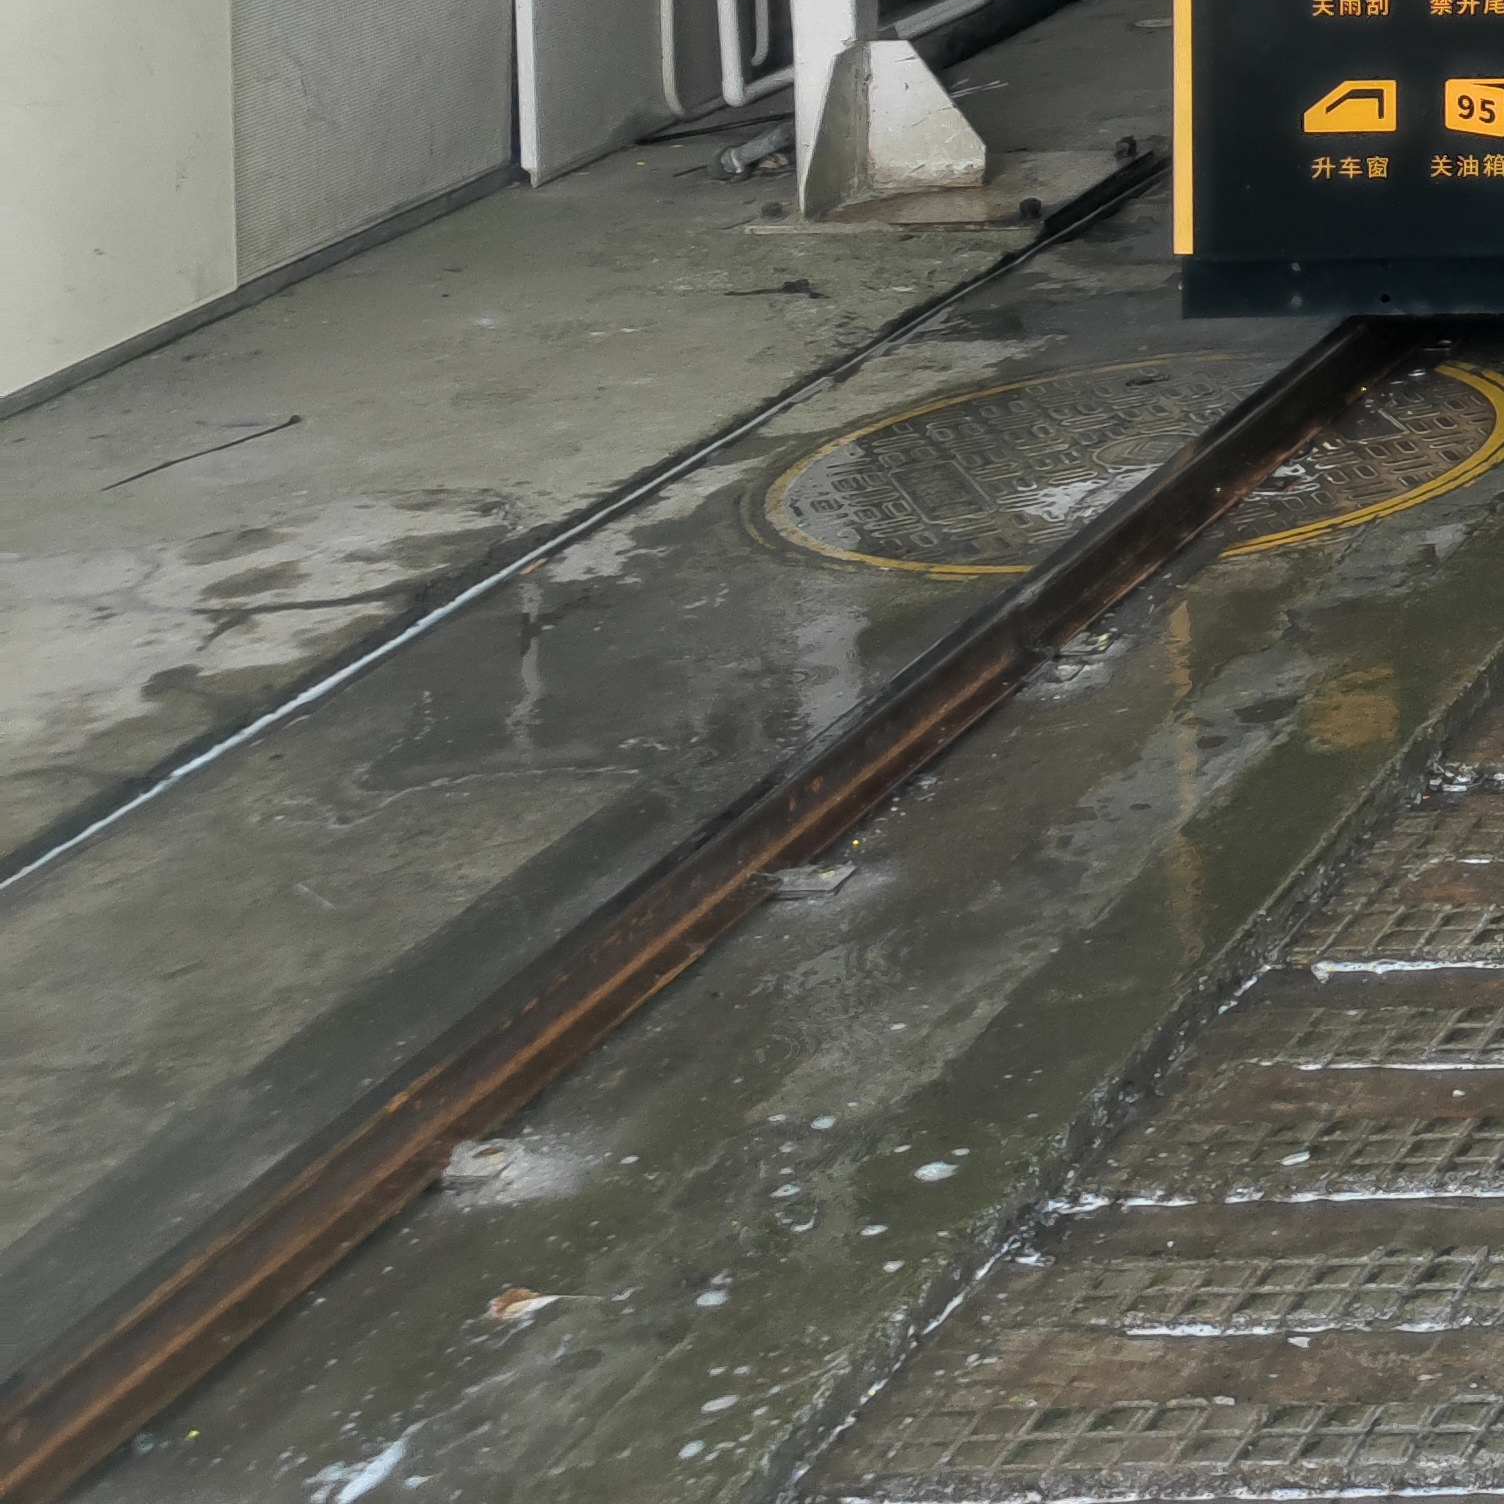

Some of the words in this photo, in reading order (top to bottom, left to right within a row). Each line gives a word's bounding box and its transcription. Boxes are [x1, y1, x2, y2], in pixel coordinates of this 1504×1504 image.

[1457, 94, 1496, 124] 95
[1311, 155, 1390, 180] 升车窗
